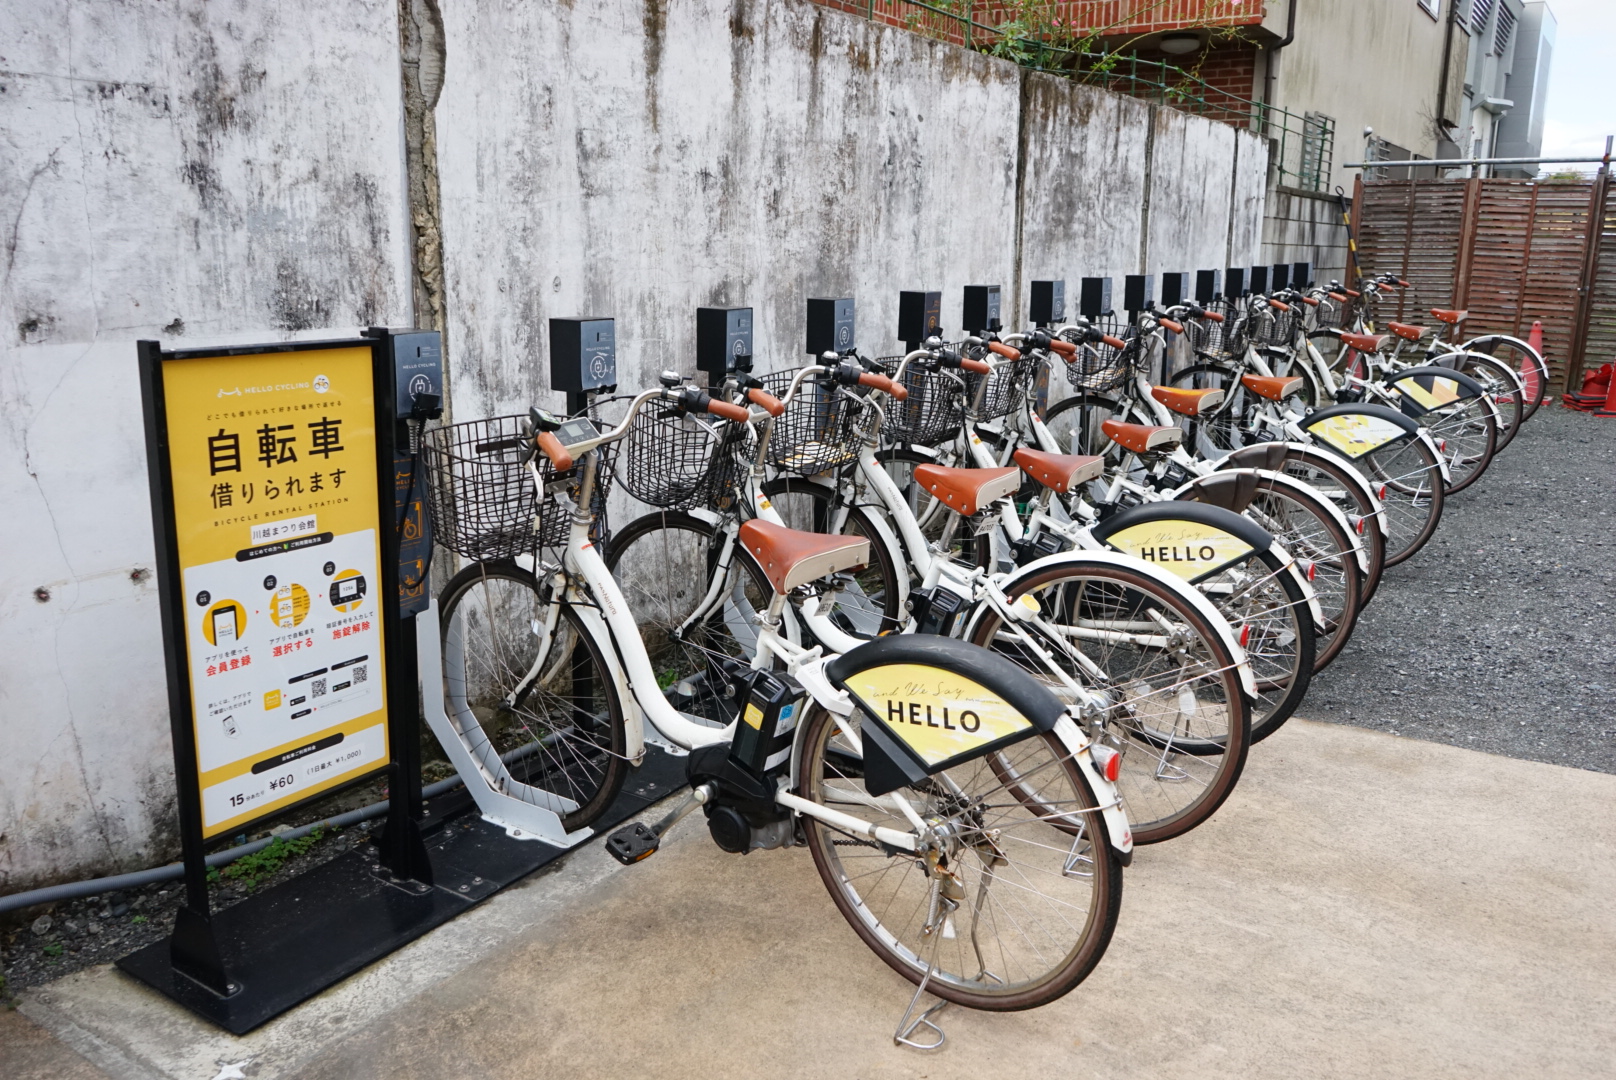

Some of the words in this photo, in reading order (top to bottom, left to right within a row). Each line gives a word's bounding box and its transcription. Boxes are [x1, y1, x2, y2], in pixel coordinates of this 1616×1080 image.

[244, 384, 274, 394] HELLO
[274, 380, 310, 392] CYCLING
[208, 416, 345, 476] 自転車
[210, 468, 347, 509] 借りられます
[214, 512, 258, 526] BICYCLE
[264, 506, 303, 518] RENTAL
[308, 497, 350, 510] STATION
[252, 518, 316, 540] 川越まつり会館
[1141, 546, 1215, 562] HELLO
[269, 628, 315, 646] アプリで自転車を
[332, 620, 371, 640] 施錠解除
[205, 646, 250, 664] アプリを使って
[272, 637, 314, 658] 選択する
[206, 655, 252, 677] 会員登録
[872, 686, 900, 698] and
[904, 682, 928, 697] We
[932, 681, 965, 700] Say
[888, 700, 980, 733] HELLO
